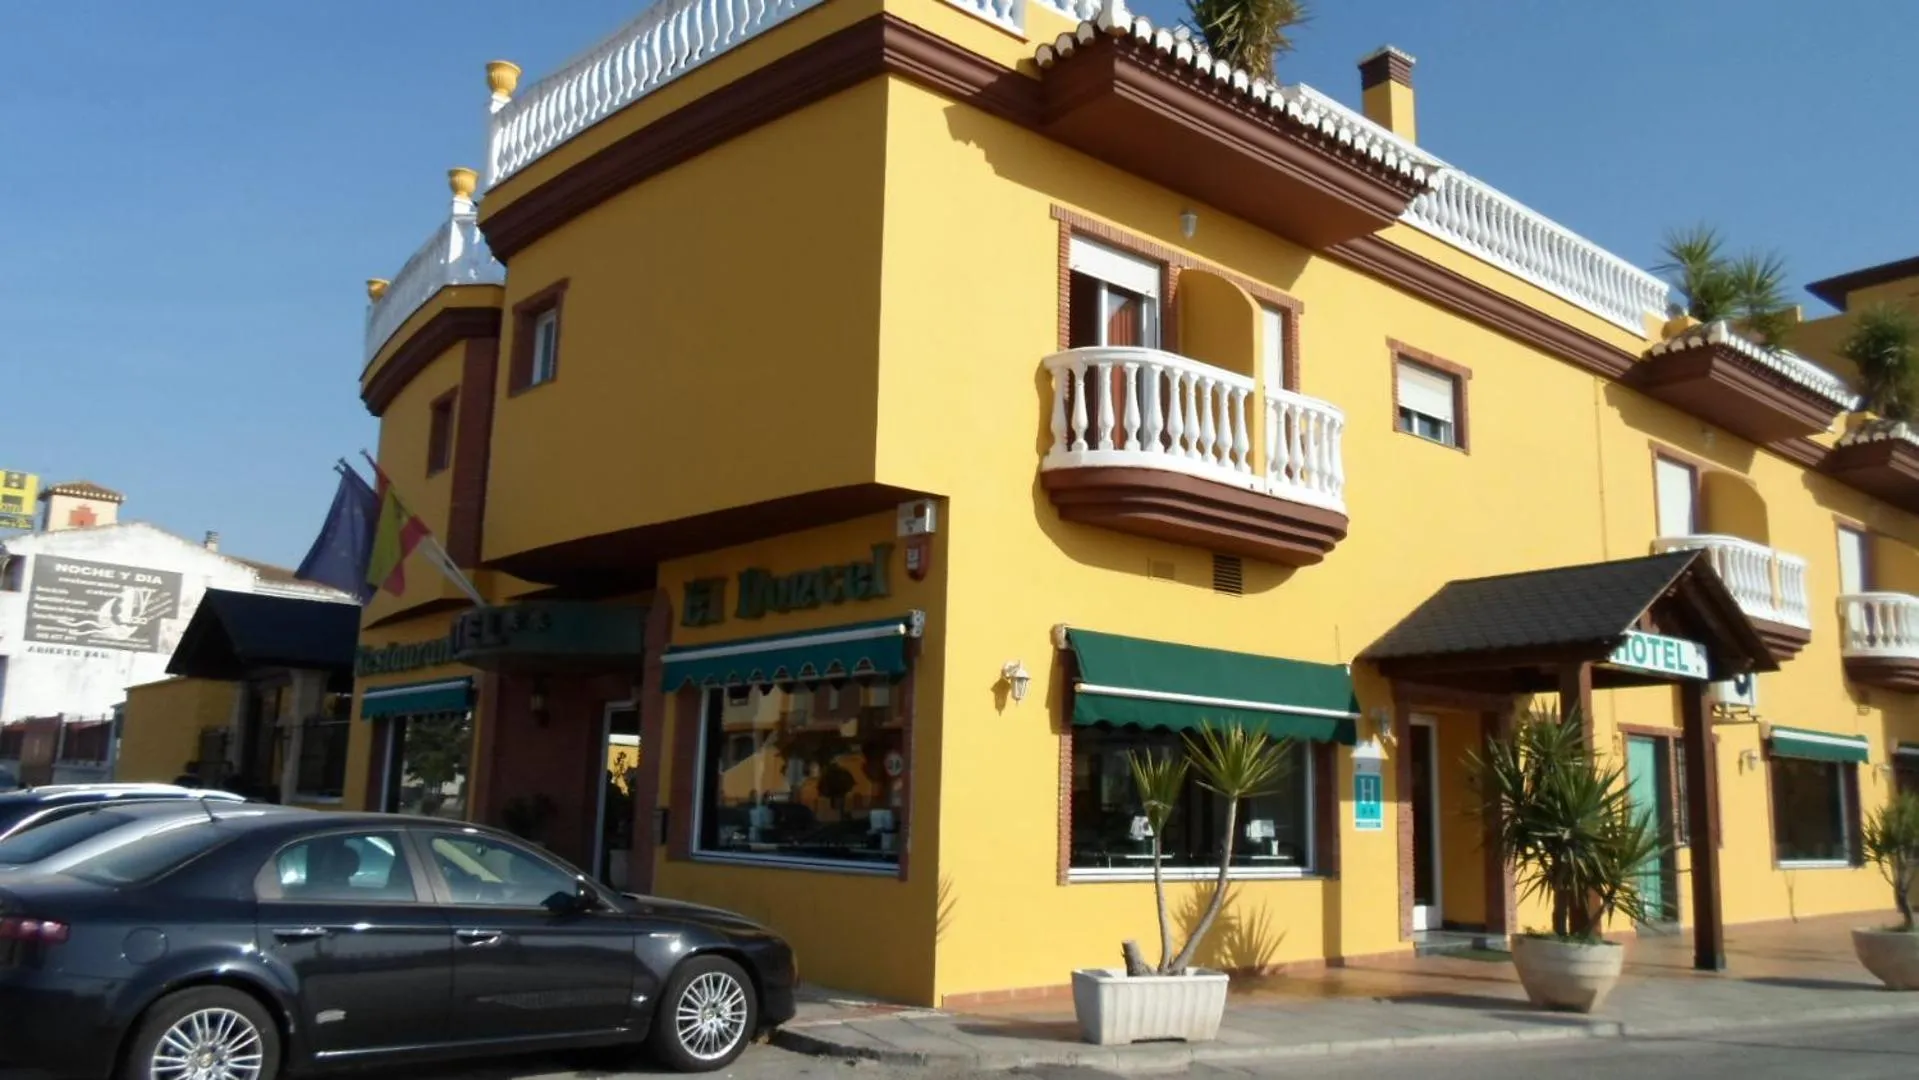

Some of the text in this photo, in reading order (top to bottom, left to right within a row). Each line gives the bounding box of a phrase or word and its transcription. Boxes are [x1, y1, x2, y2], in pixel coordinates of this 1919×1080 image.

[55, 563, 115, 579] NOCHE
[120, 571, 131, 580] Y
[1359, 777, 1376, 804] H
